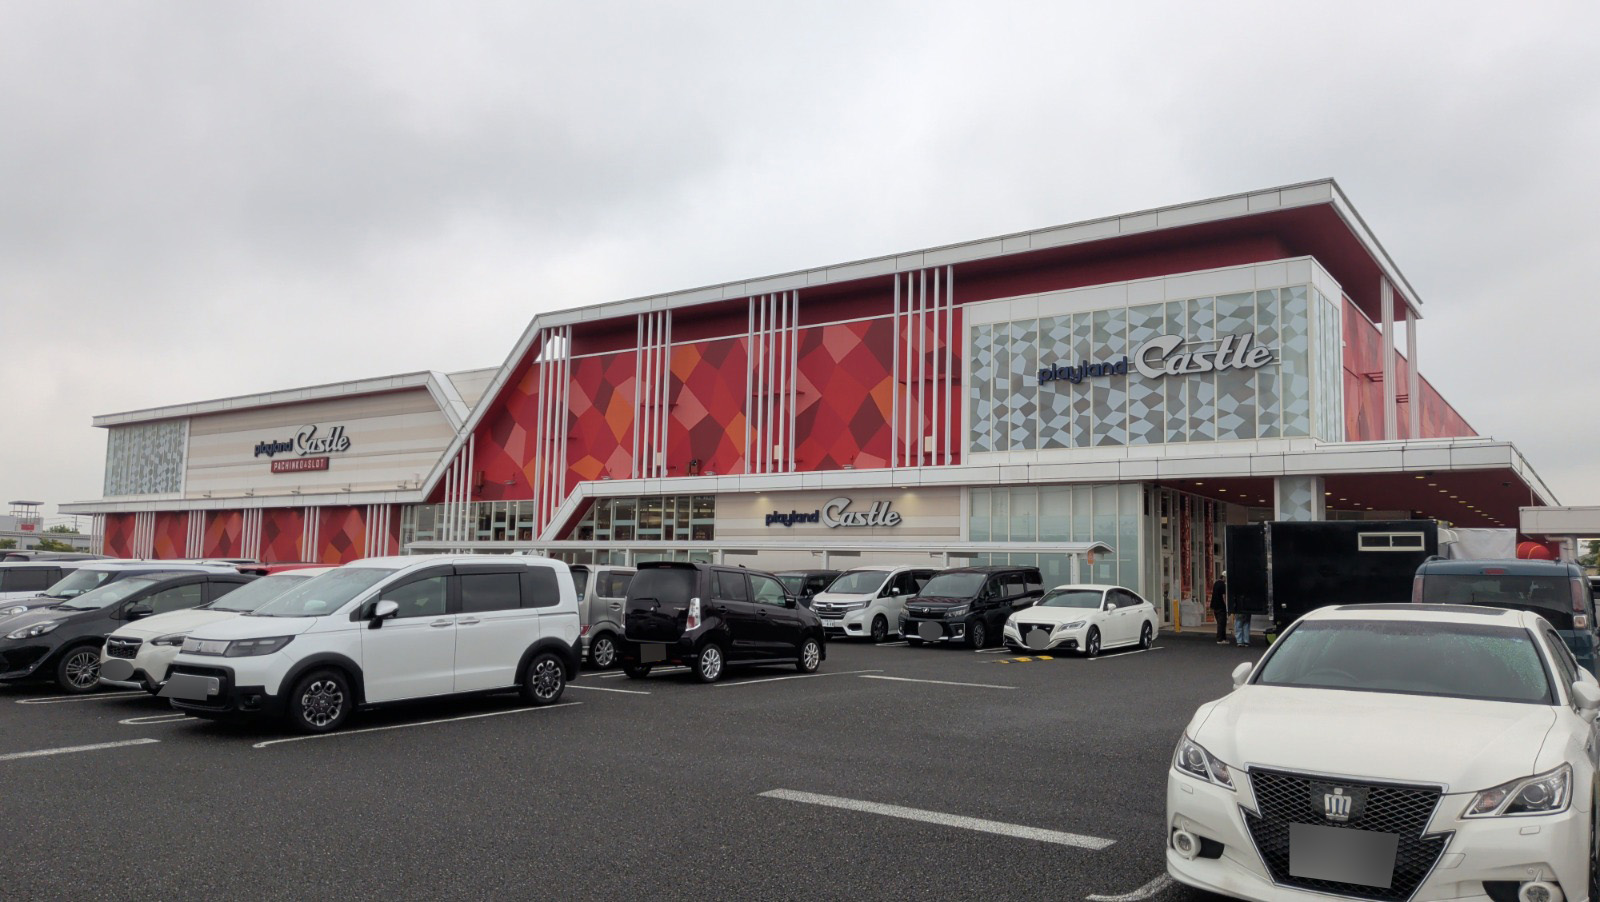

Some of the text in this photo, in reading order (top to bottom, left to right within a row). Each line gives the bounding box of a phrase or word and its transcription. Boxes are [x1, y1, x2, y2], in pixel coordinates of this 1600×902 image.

[1038, 332, 1274, 385] playland Castle
[254, 424, 351, 457] playland Castle
[765, 496, 902, 528] playland Castle
